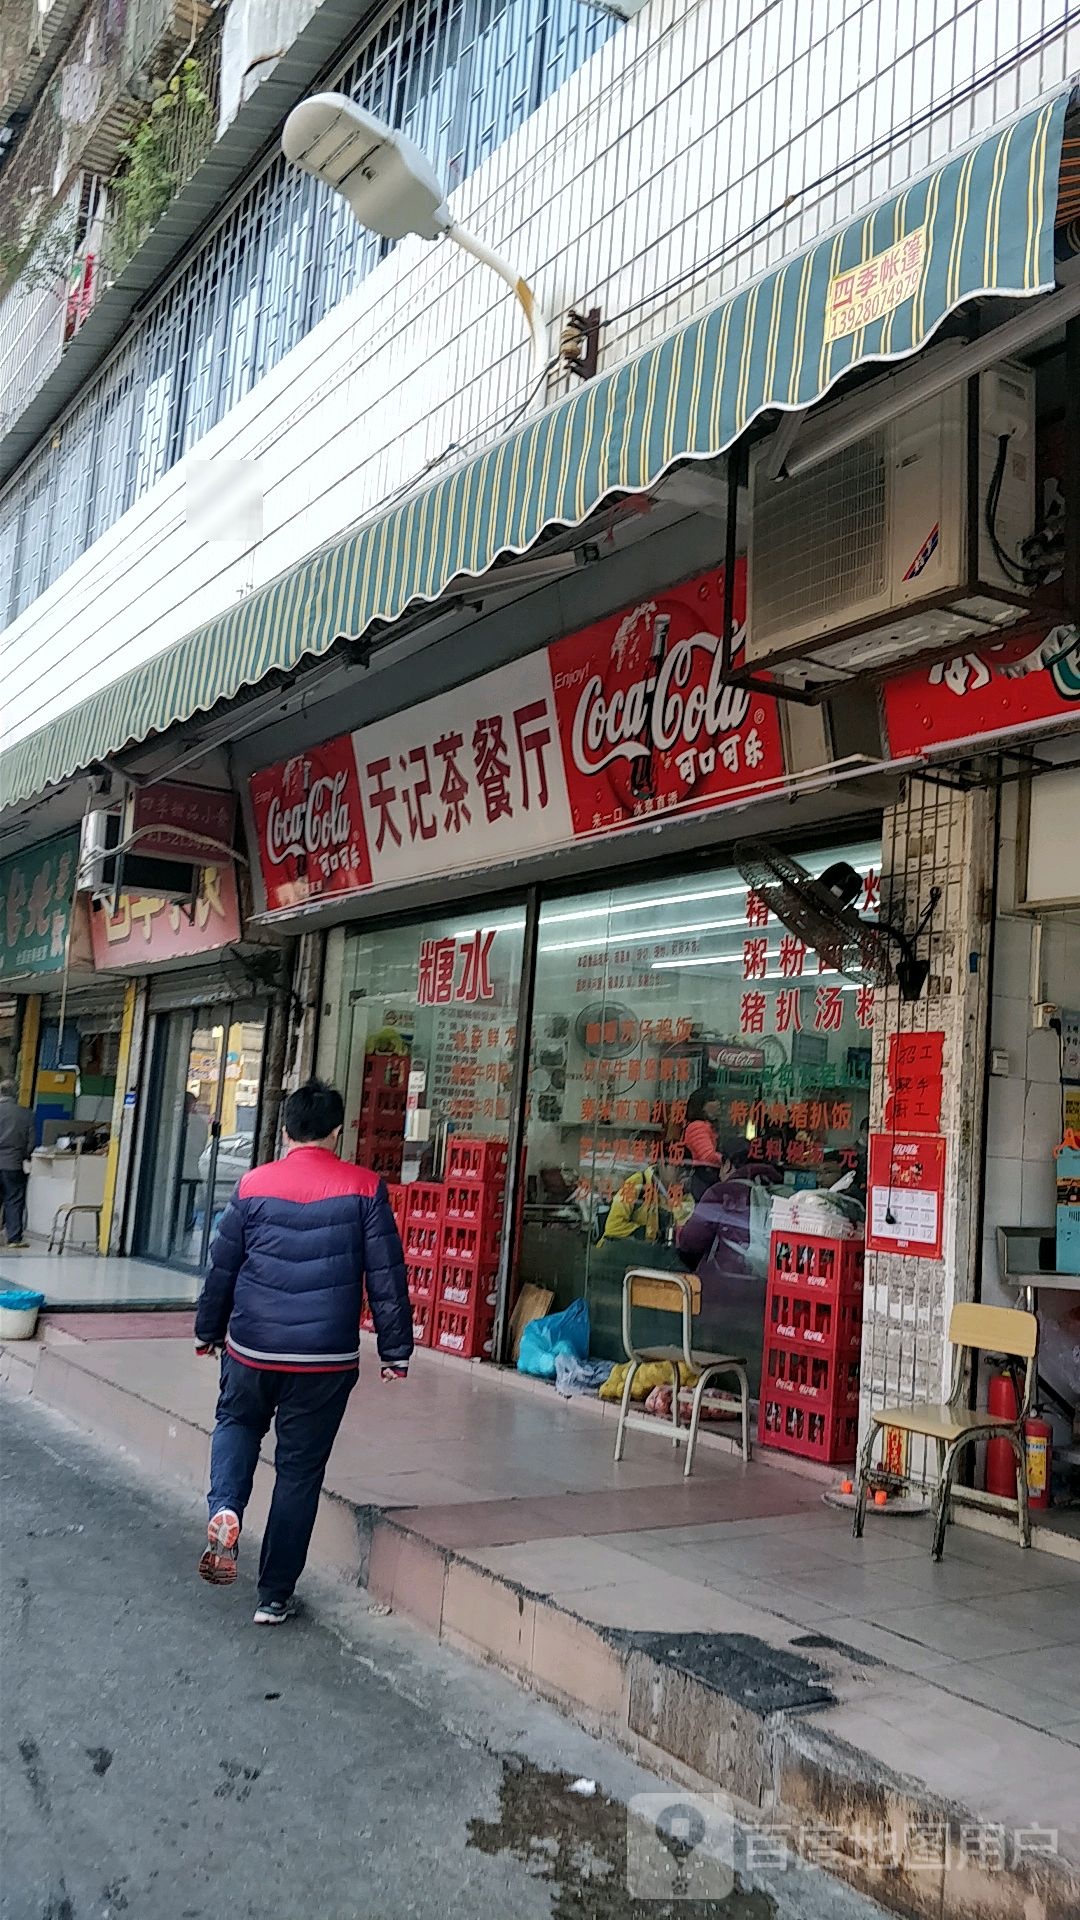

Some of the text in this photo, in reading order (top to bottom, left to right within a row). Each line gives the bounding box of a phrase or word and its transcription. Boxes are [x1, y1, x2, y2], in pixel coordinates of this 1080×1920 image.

[832, 233, 924, 312] 四季帐篷
[553, 662, 591, 690] Enjoy!
[367, 697, 553, 855] 天记茶餐厅
[674, 727, 765, 785] 可口可乐
[266, 767, 351, 865] Coca-Cola
[416, 929, 498, 1008] 糖水
[837, 1149, 859, 1169] 元
